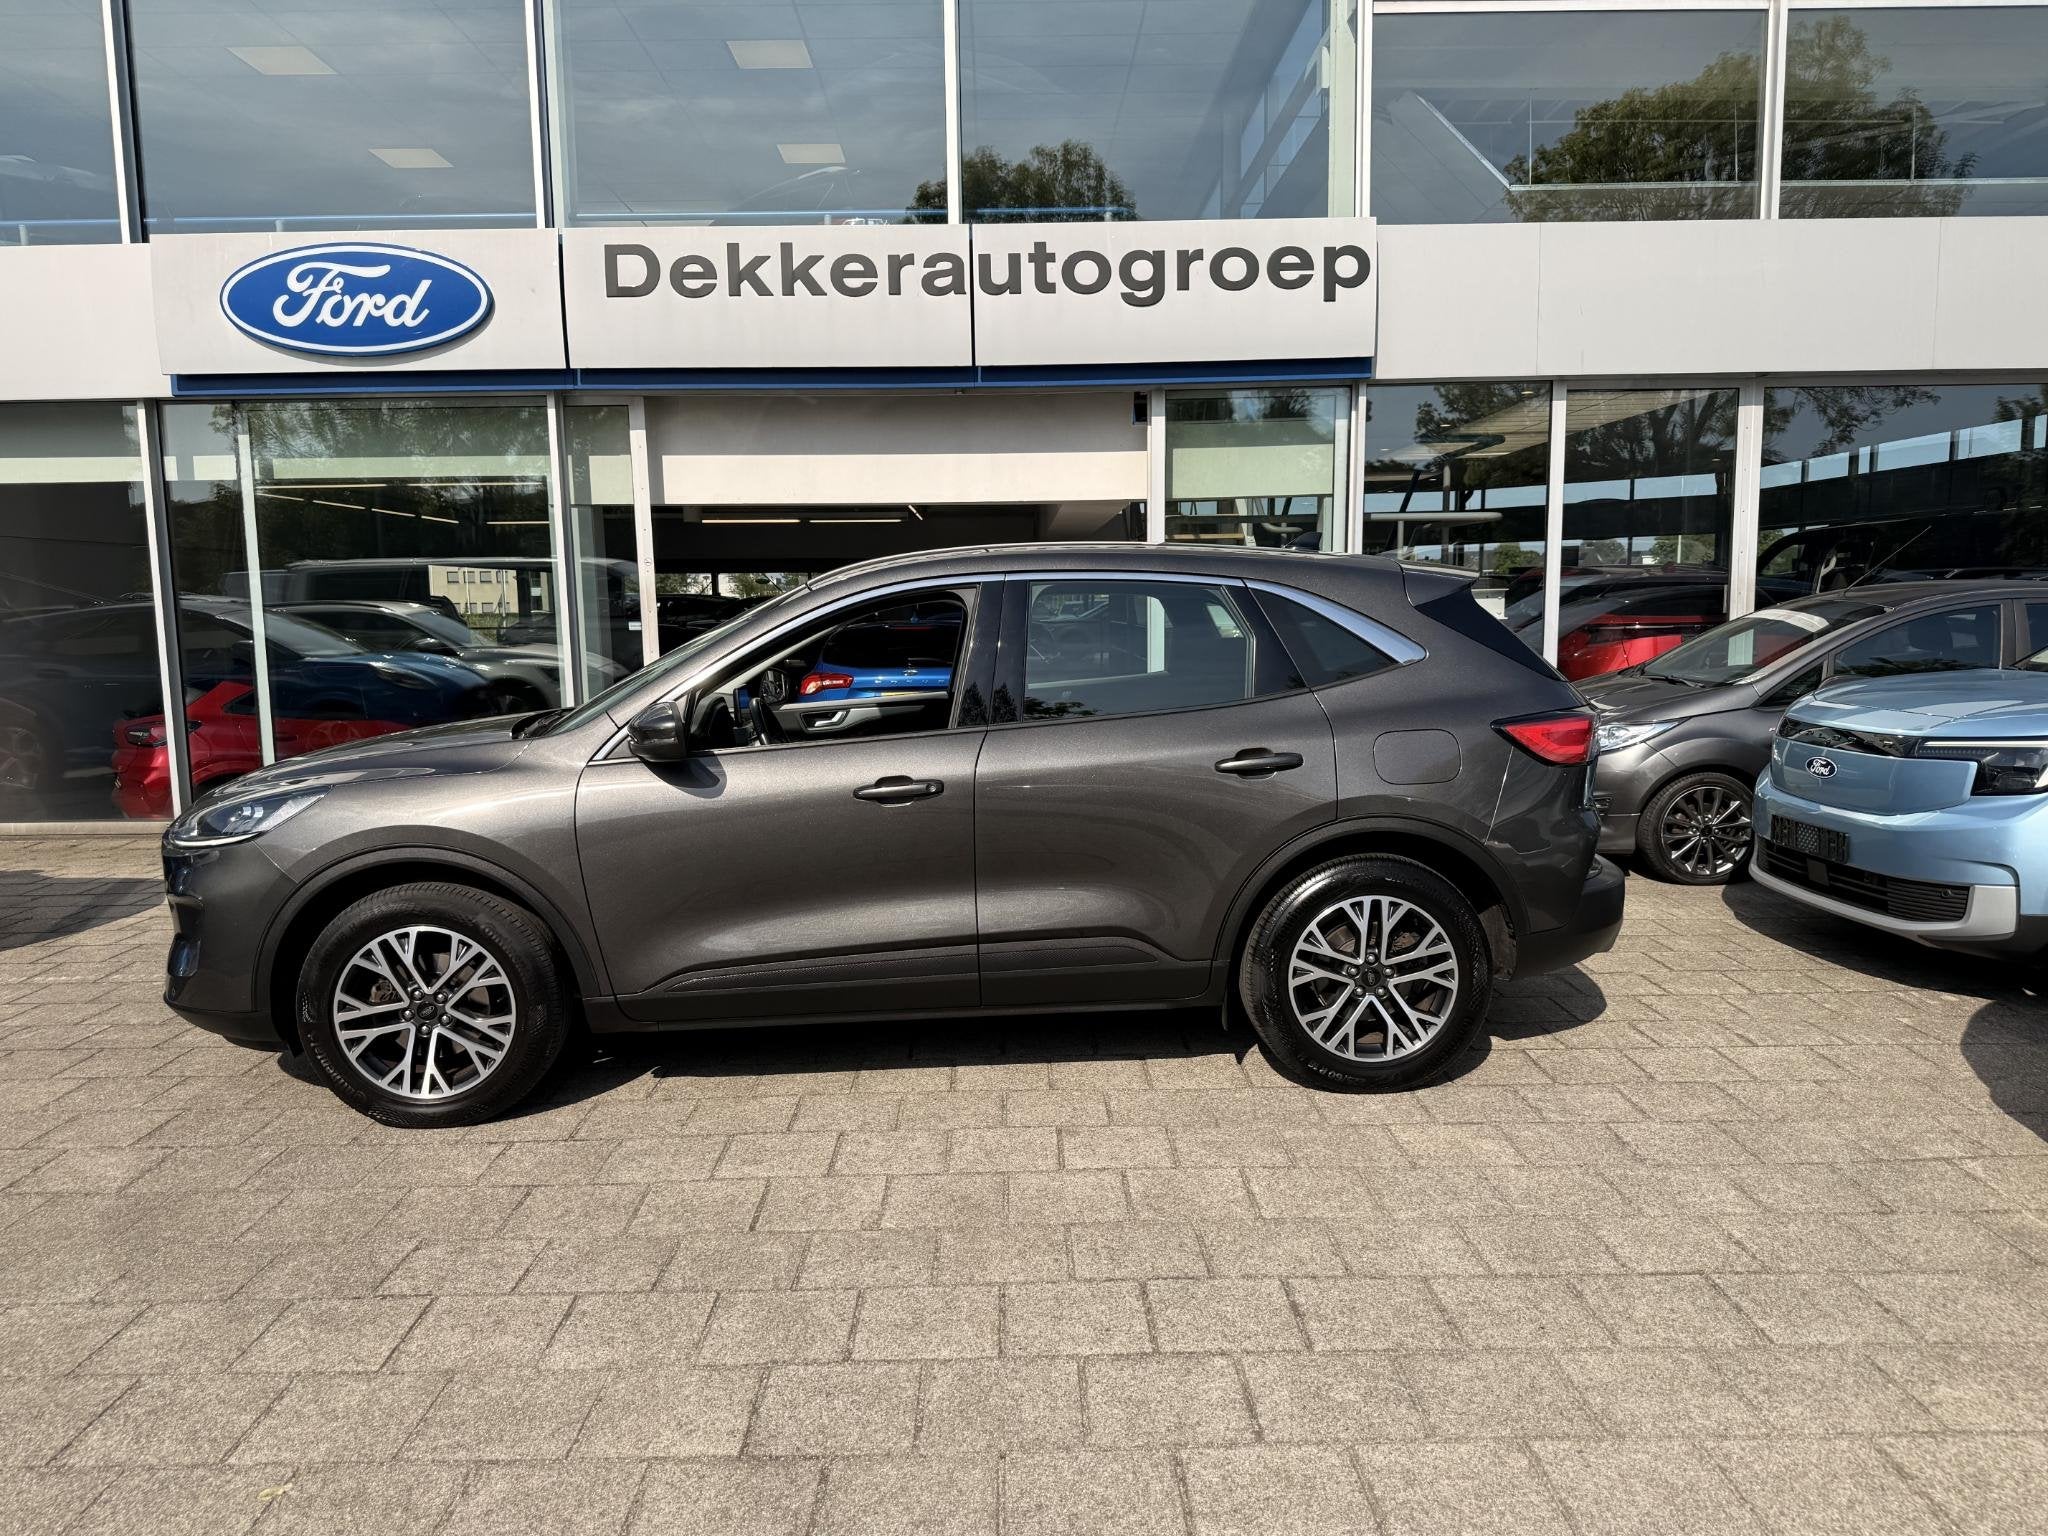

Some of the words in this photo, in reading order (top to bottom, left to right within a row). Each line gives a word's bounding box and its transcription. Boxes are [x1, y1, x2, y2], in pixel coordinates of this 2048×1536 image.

[272, 261, 433, 327] Ford
[603, 242, 1372, 308] Dekkerautogroep
[1810, 758, 1831, 775] Ford
